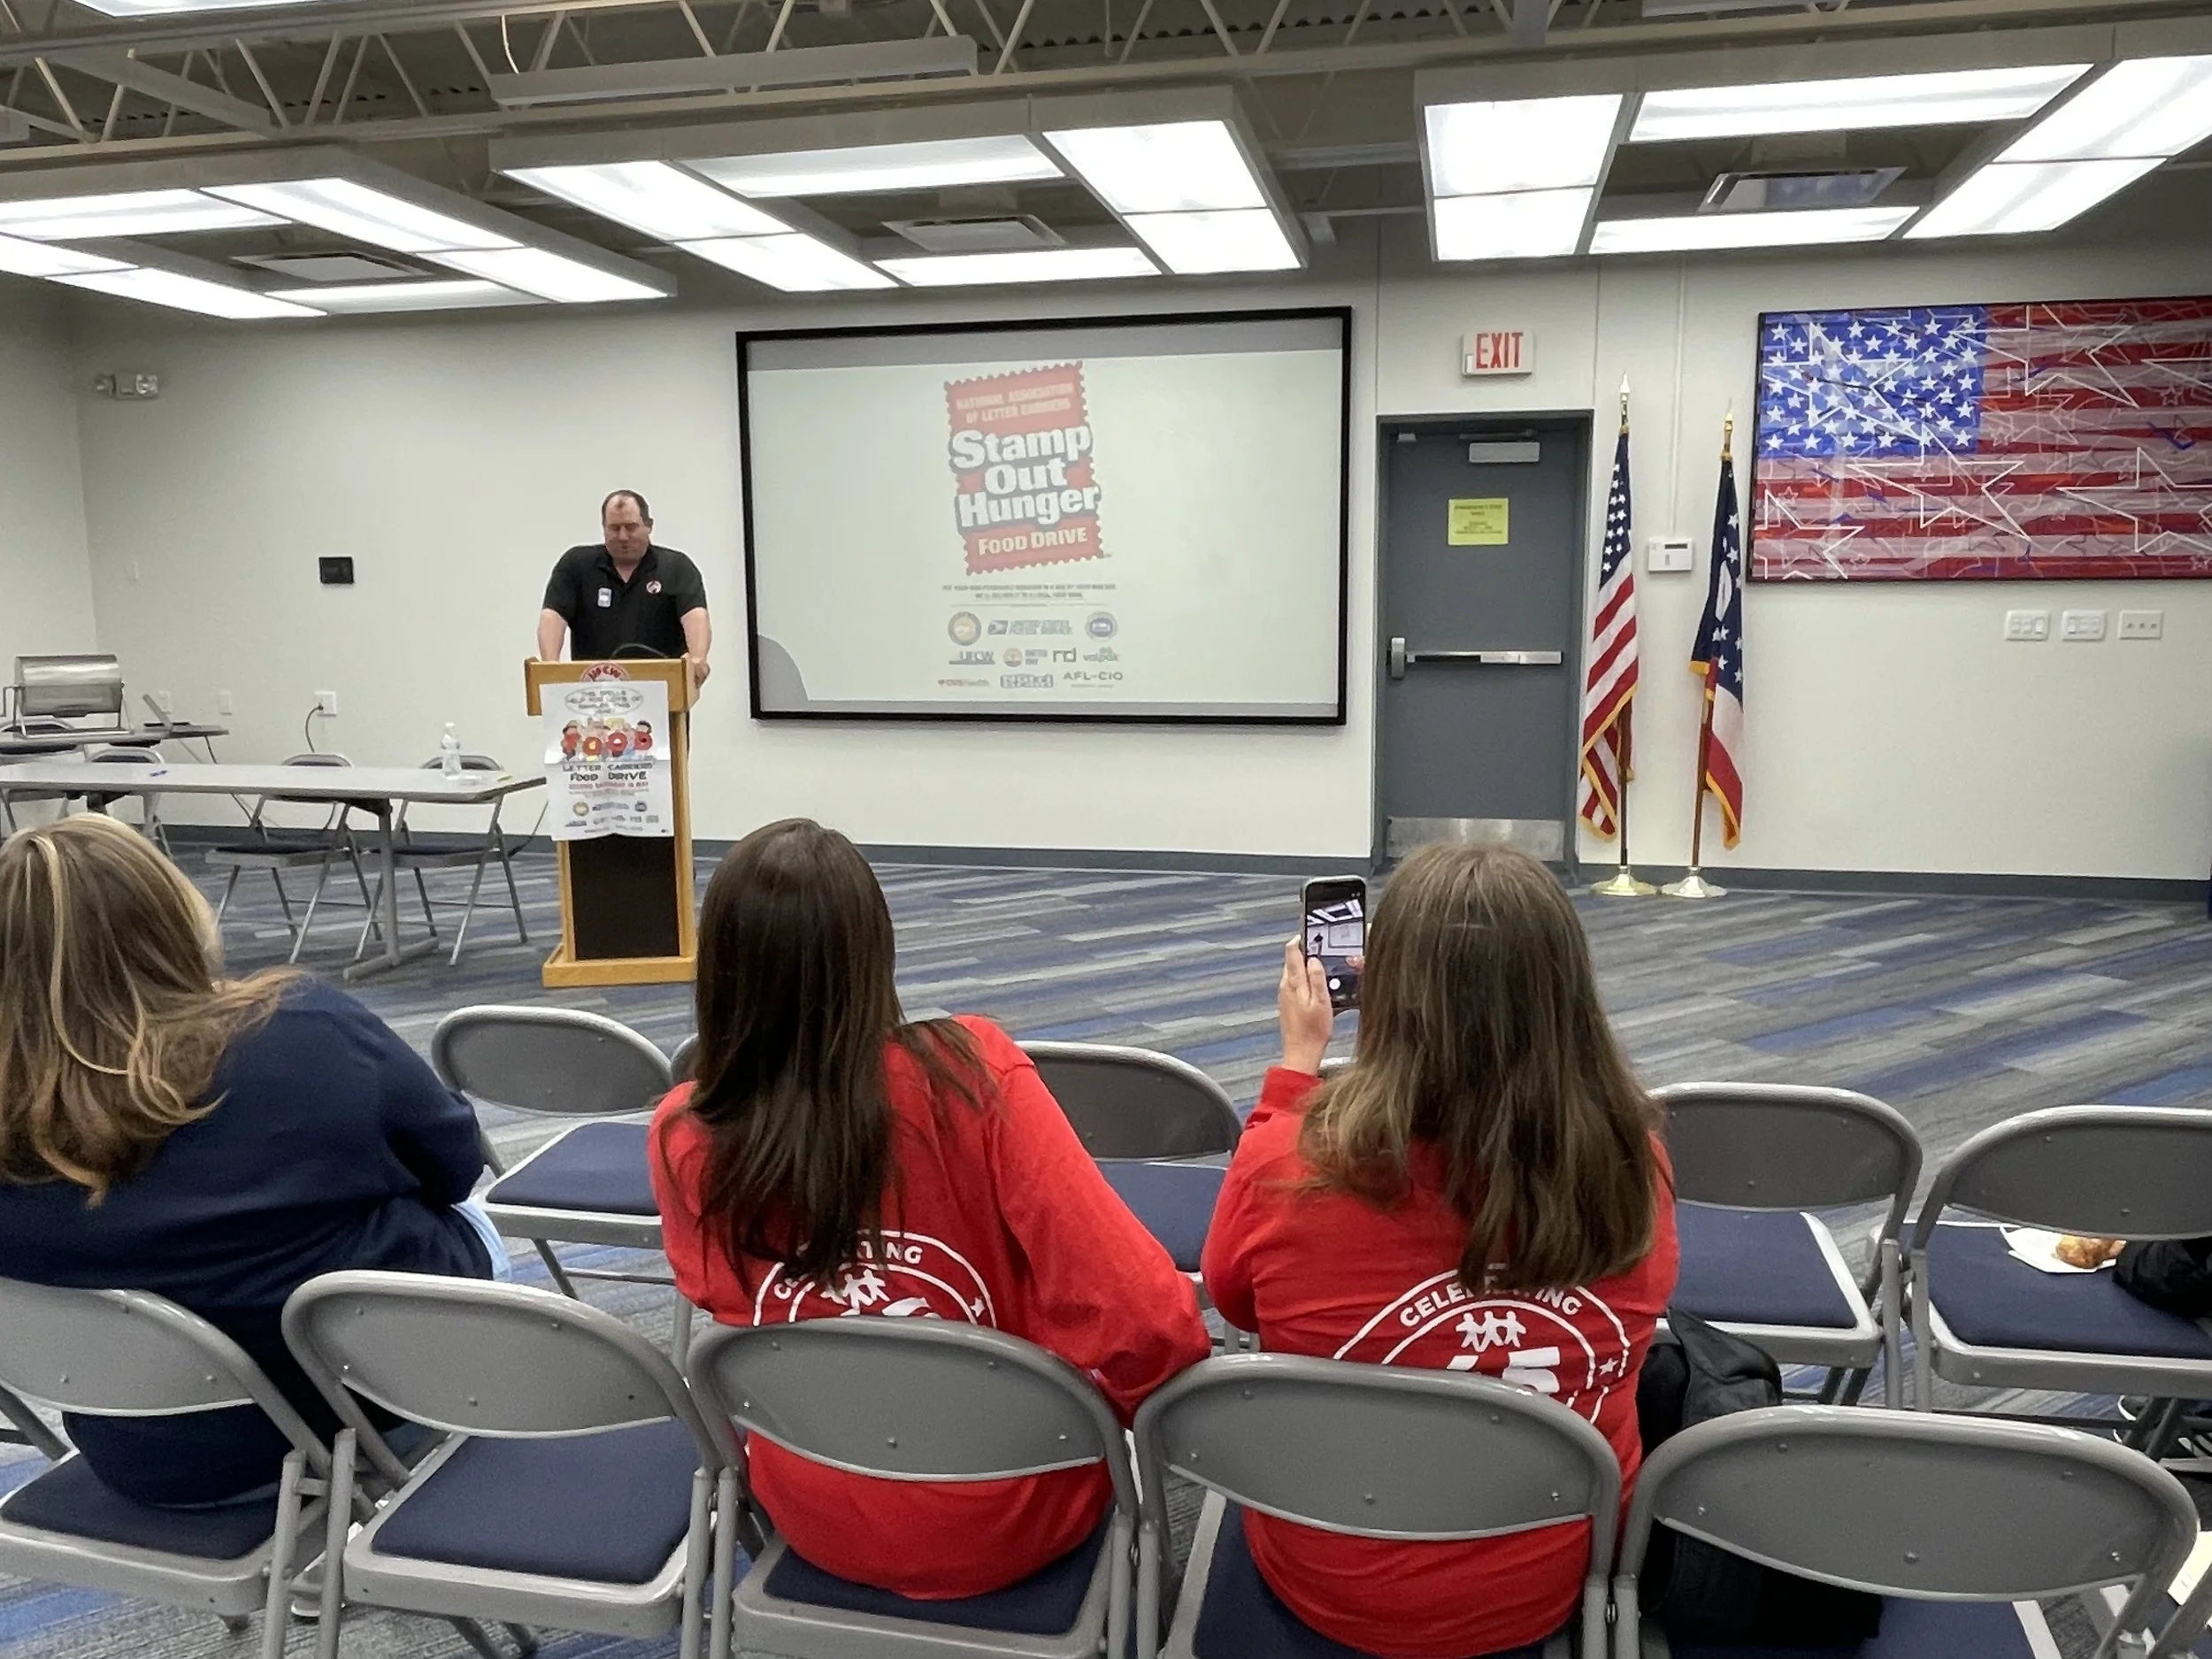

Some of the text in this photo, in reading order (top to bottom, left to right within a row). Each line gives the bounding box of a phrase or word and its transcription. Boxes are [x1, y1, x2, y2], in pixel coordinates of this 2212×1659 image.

[1476, 332, 1524, 369] EXIT
[952, 426, 1091, 469] Stamp
[985, 457, 1068, 495] Out
[958, 487, 1101, 527] Hunger
[978, 527, 1088, 556] FOOD DRIVE
[1063, 671, 1124, 680] AFL-CIO
[570, 771, 648, 781] FOOD DRIVE
[1400, 1275, 1583, 1326] CELEING
